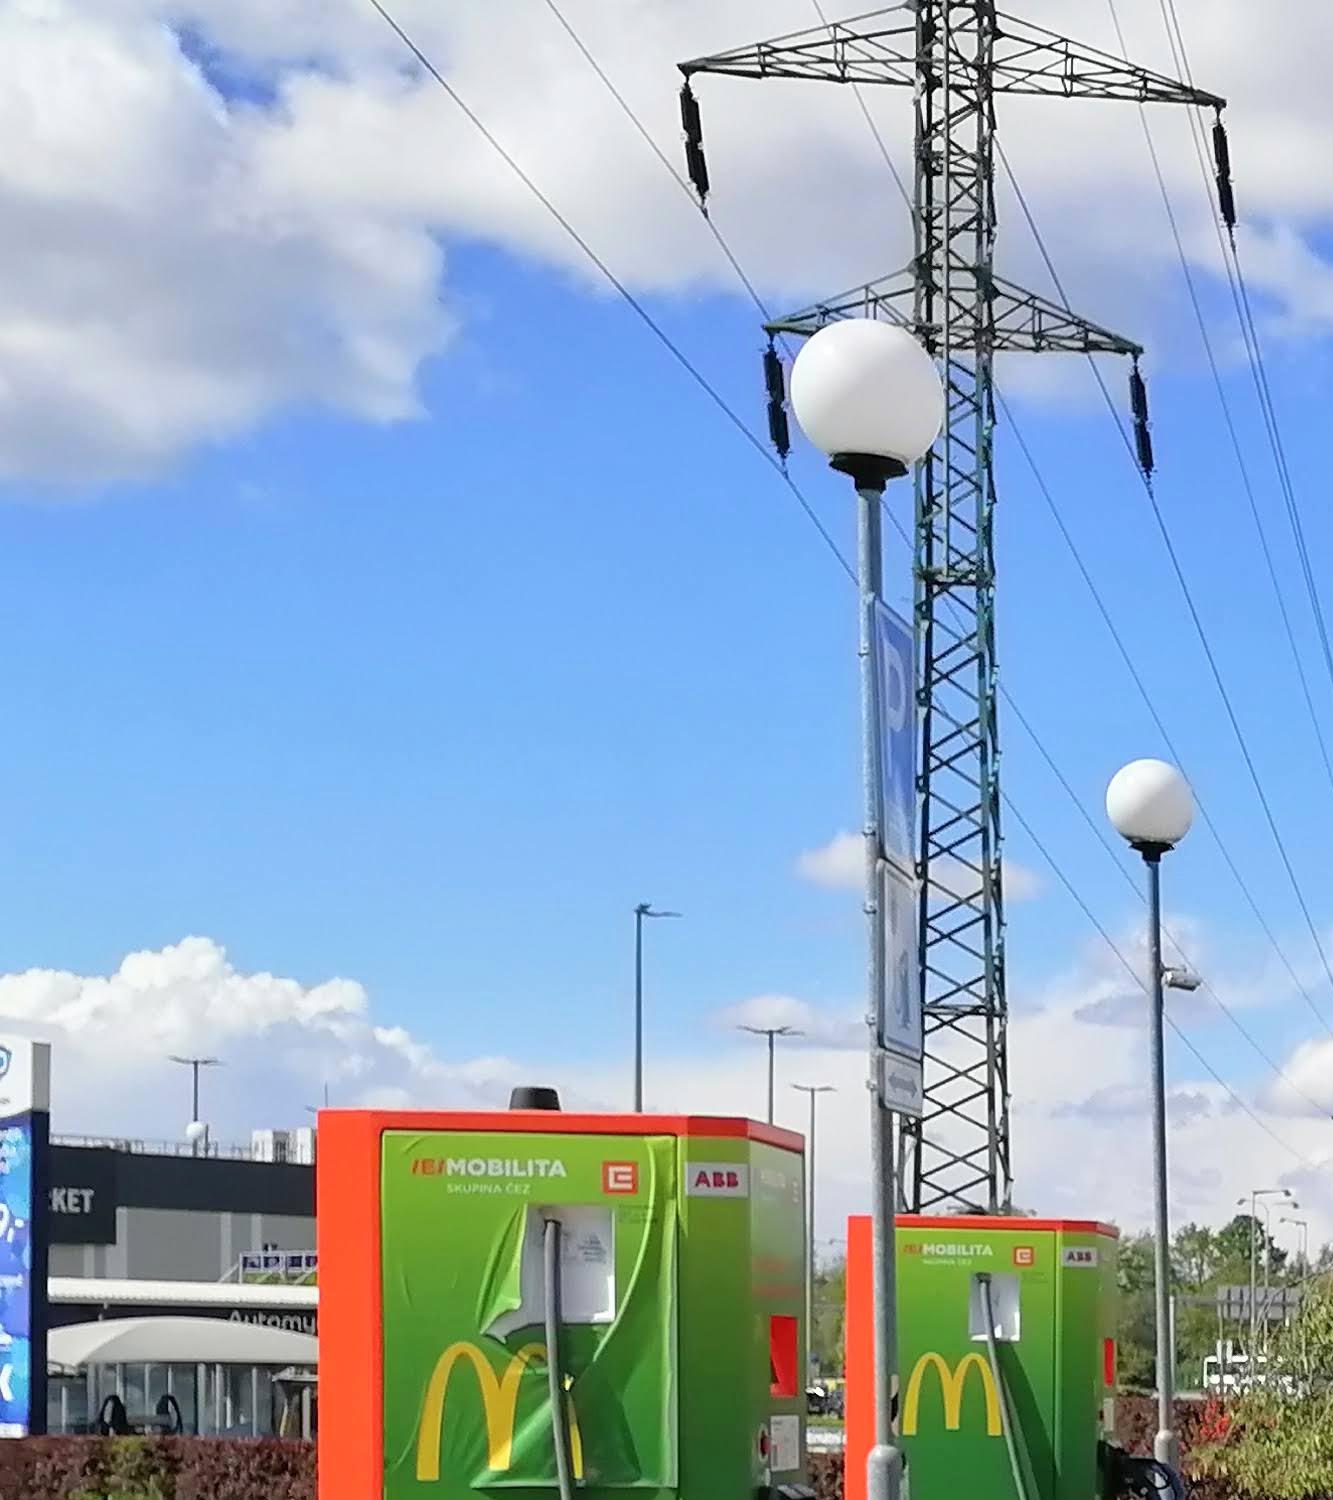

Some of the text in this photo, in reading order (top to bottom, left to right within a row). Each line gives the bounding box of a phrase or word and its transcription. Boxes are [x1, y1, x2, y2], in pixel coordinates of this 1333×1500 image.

[695, 1170, 739, 1188] ABB
[447, 1184, 502, 1194] SKUPINA
[49, 1187, 95, 1213] KET
